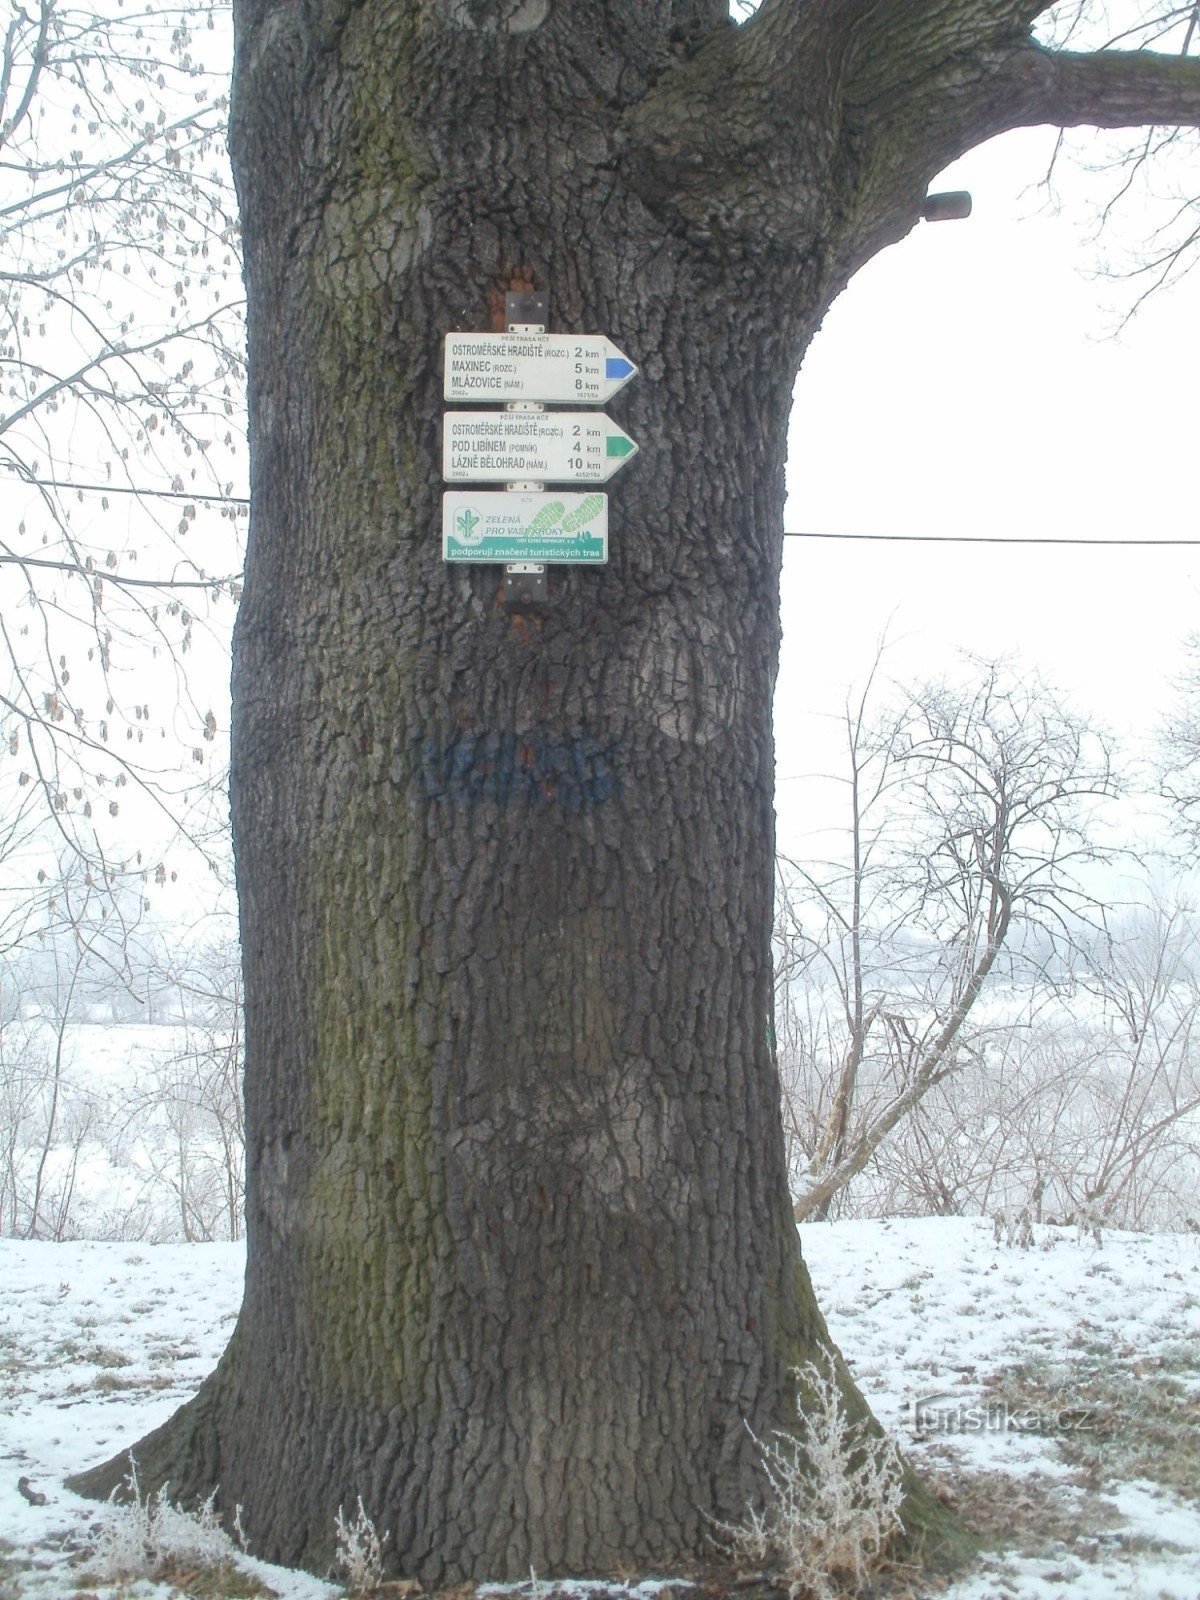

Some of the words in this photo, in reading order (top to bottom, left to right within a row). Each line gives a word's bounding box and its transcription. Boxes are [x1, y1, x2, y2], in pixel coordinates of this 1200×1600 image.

[452, 342, 506, 356] OSTROMĚŘSKÉ
[508, 344, 543, 357] HRADIŠTĚ
[574, 347, 582, 358] 2
[585, 350, 599, 358] km
[452, 360, 491, 372] MAXINEC
[492, 365, 517, 374] (ROZC.)
[575, 363, 583, 374] 5
[585, 366, 599, 374] km
[452, 374, 502, 388] MLÁZOVICE
[575, 379, 583, 390] 8
[585, 382, 599, 390] km
[452, 421, 503, 435] OSTROMĚŘSKÉ
[504, 422, 538, 436] HRADIŠTĚ
[538, 427, 563, 437] (ROZC.)
[573, 425, 581, 436] 2
[586, 429, 601, 437] km
[452, 440, 471, 452] POD
[472, 438, 507, 452] LIBÍNEM
[573, 441, 581, 453] 4
[586, 445, 601, 453] km
[452, 454, 479, 469] LÁZNĚ
[480, 454, 525, 469] BĚLOHRAD
[568, 458, 583, 469] 10
[586, 461, 601, 470] km
[485, 515, 521, 524] ZELENÁ
[485, 527, 506, 535] PRO
[532, 527, 565, 536] KROKY
[451, 547, 493, 557] podporují
[494, 548, 528, 556] značení
[530, 548, 581, 558] turistických
[583, 549, 600, 557] tras
